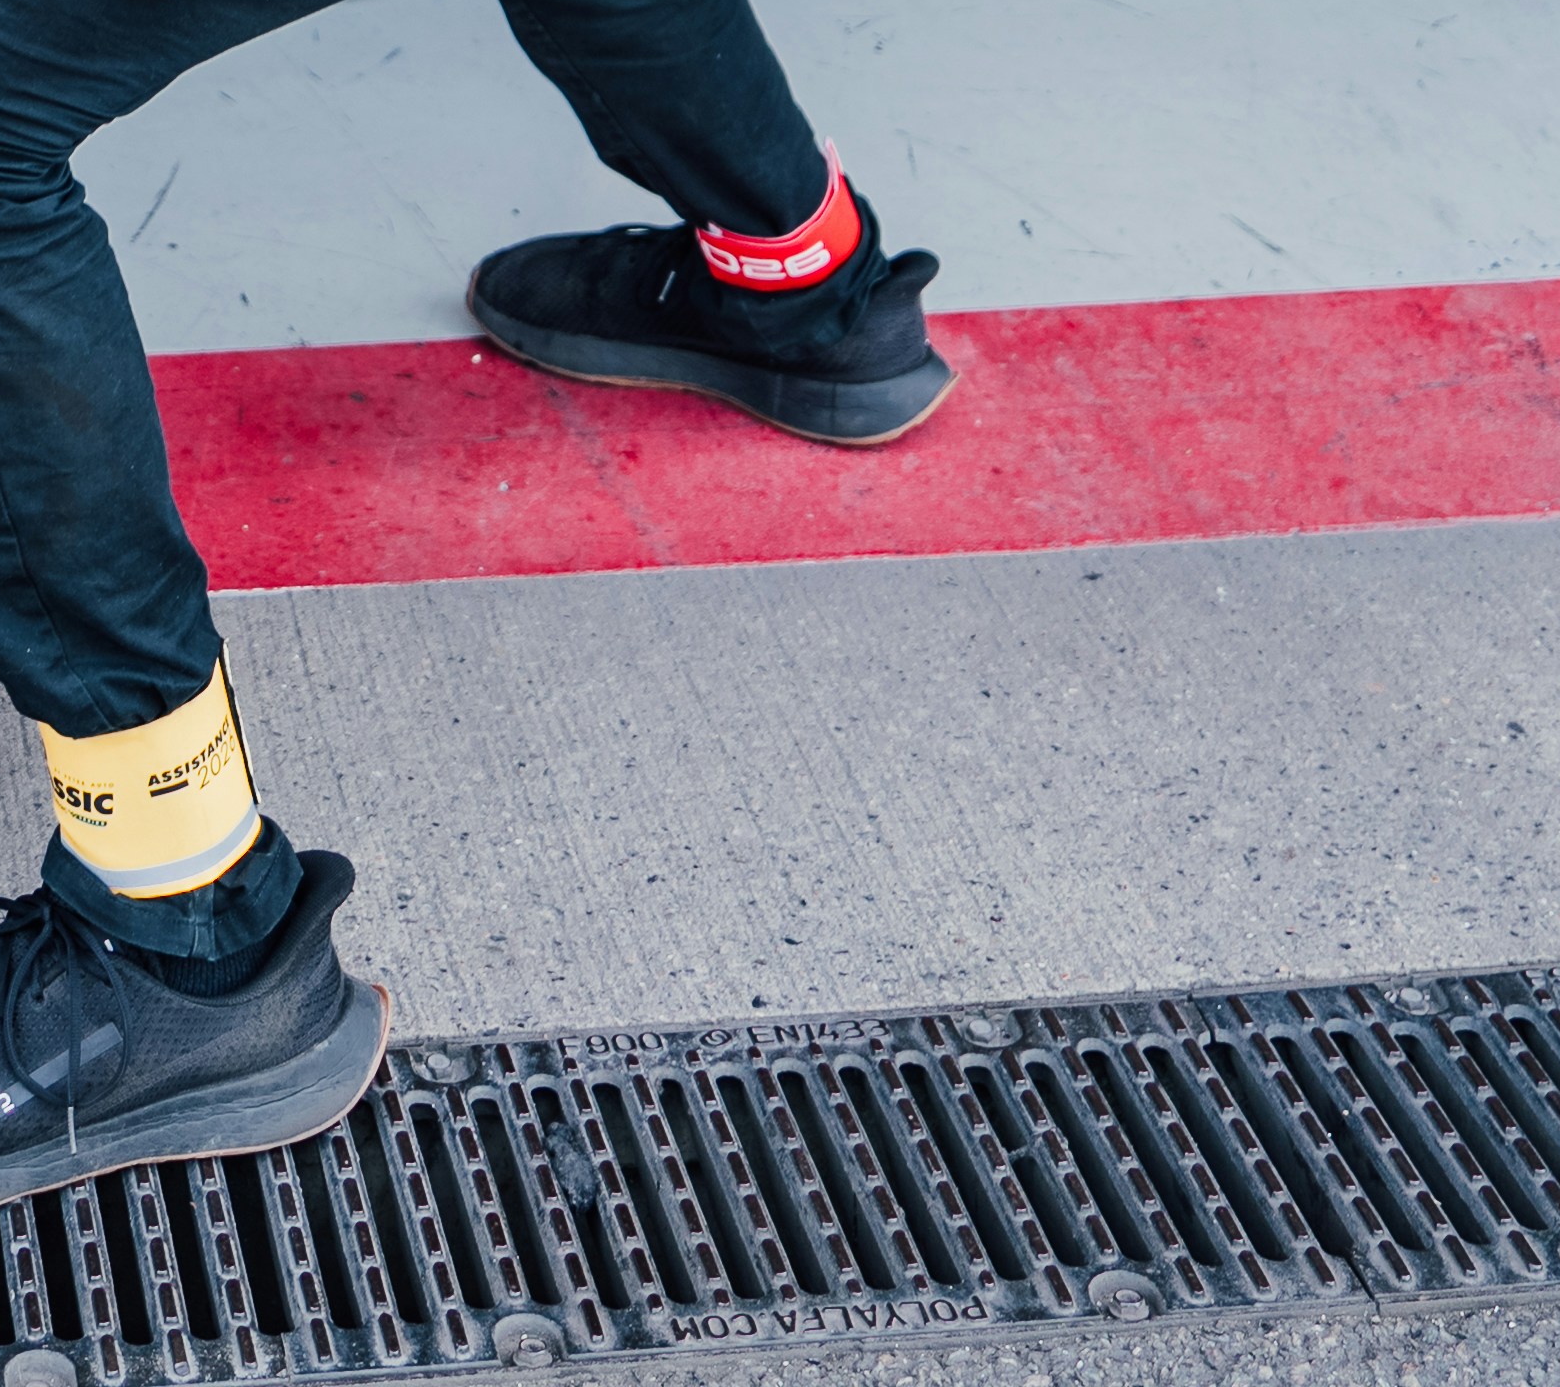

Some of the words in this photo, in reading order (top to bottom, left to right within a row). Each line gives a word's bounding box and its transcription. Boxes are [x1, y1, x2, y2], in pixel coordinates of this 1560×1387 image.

[53, 776, 114, 815] SSIC
[557, 1031, 665, 1060] F900
[747, 1019, 890, 1047] EN1433
[670, 1295, 990, 1342] POLYALFA.COM
